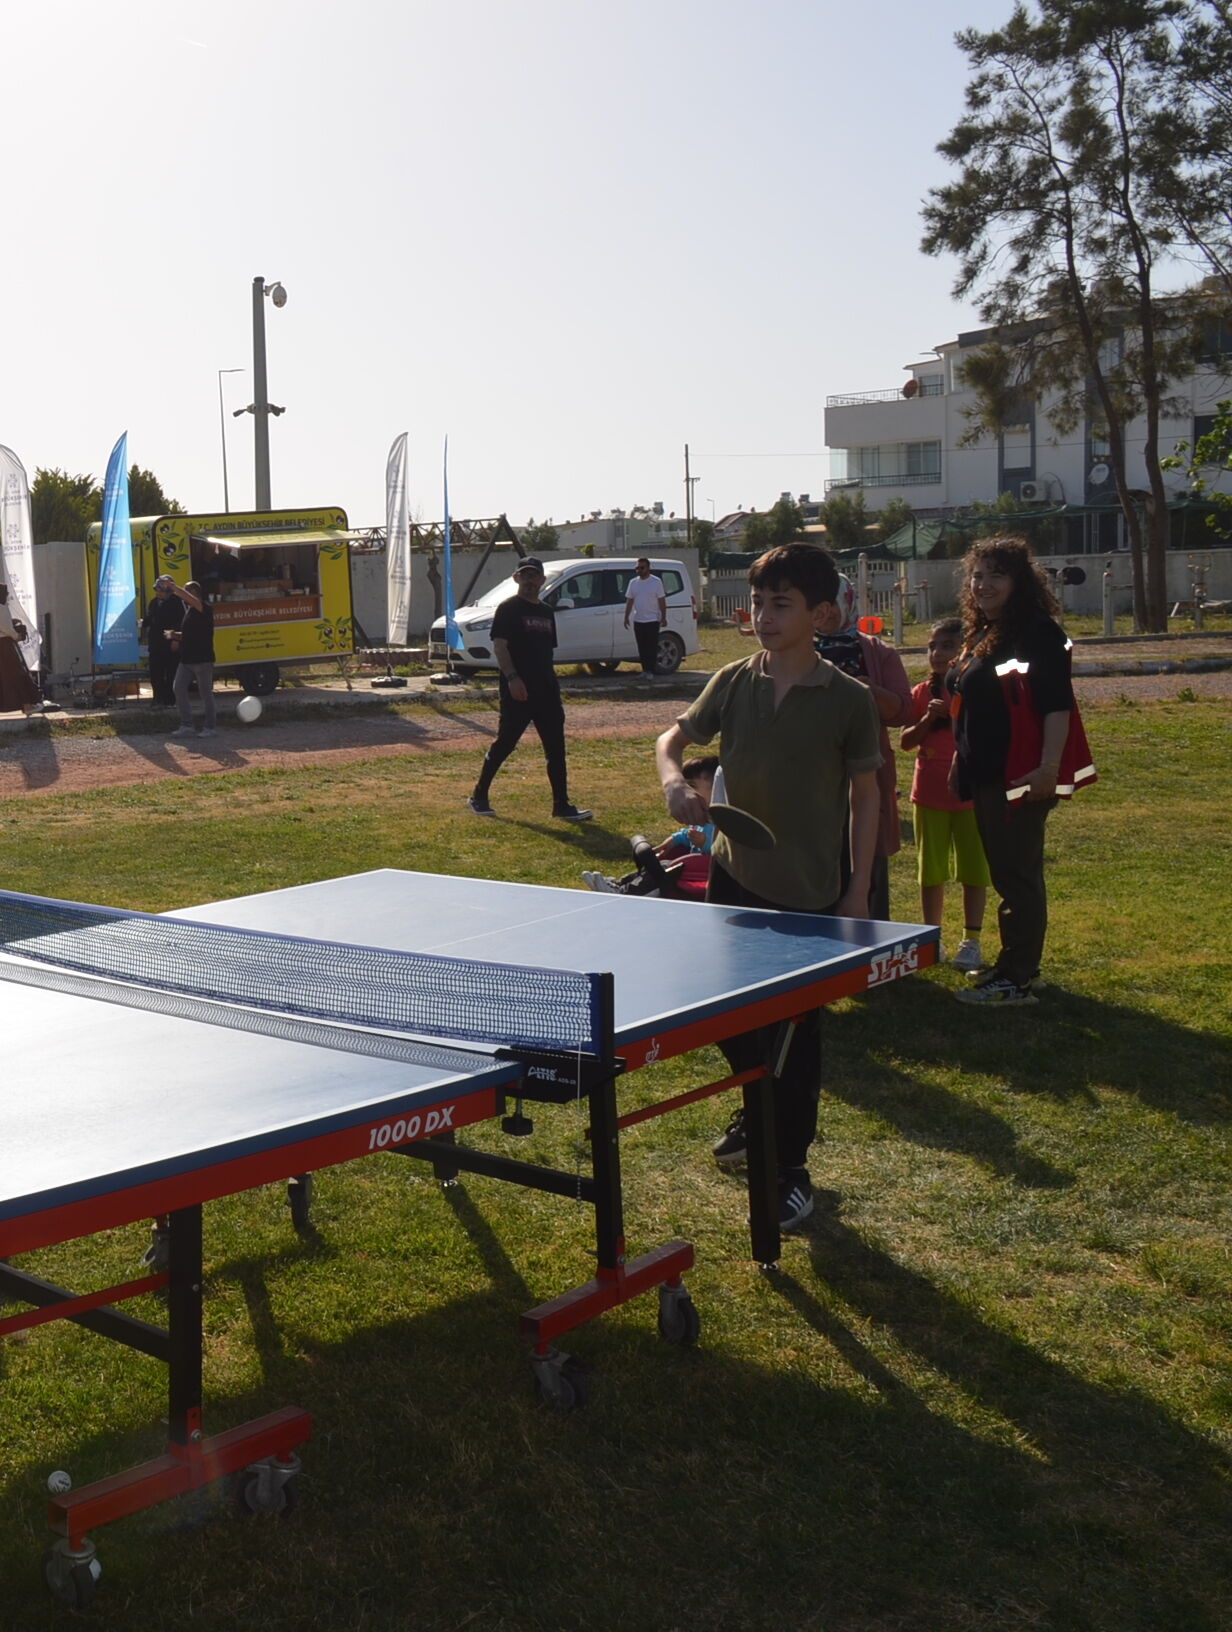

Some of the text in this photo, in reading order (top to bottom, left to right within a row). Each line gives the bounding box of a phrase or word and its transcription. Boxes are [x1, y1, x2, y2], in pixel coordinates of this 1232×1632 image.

[867, 942, 919, 984] STAG
[368, 1104, 456, 1150] 1000 DX
